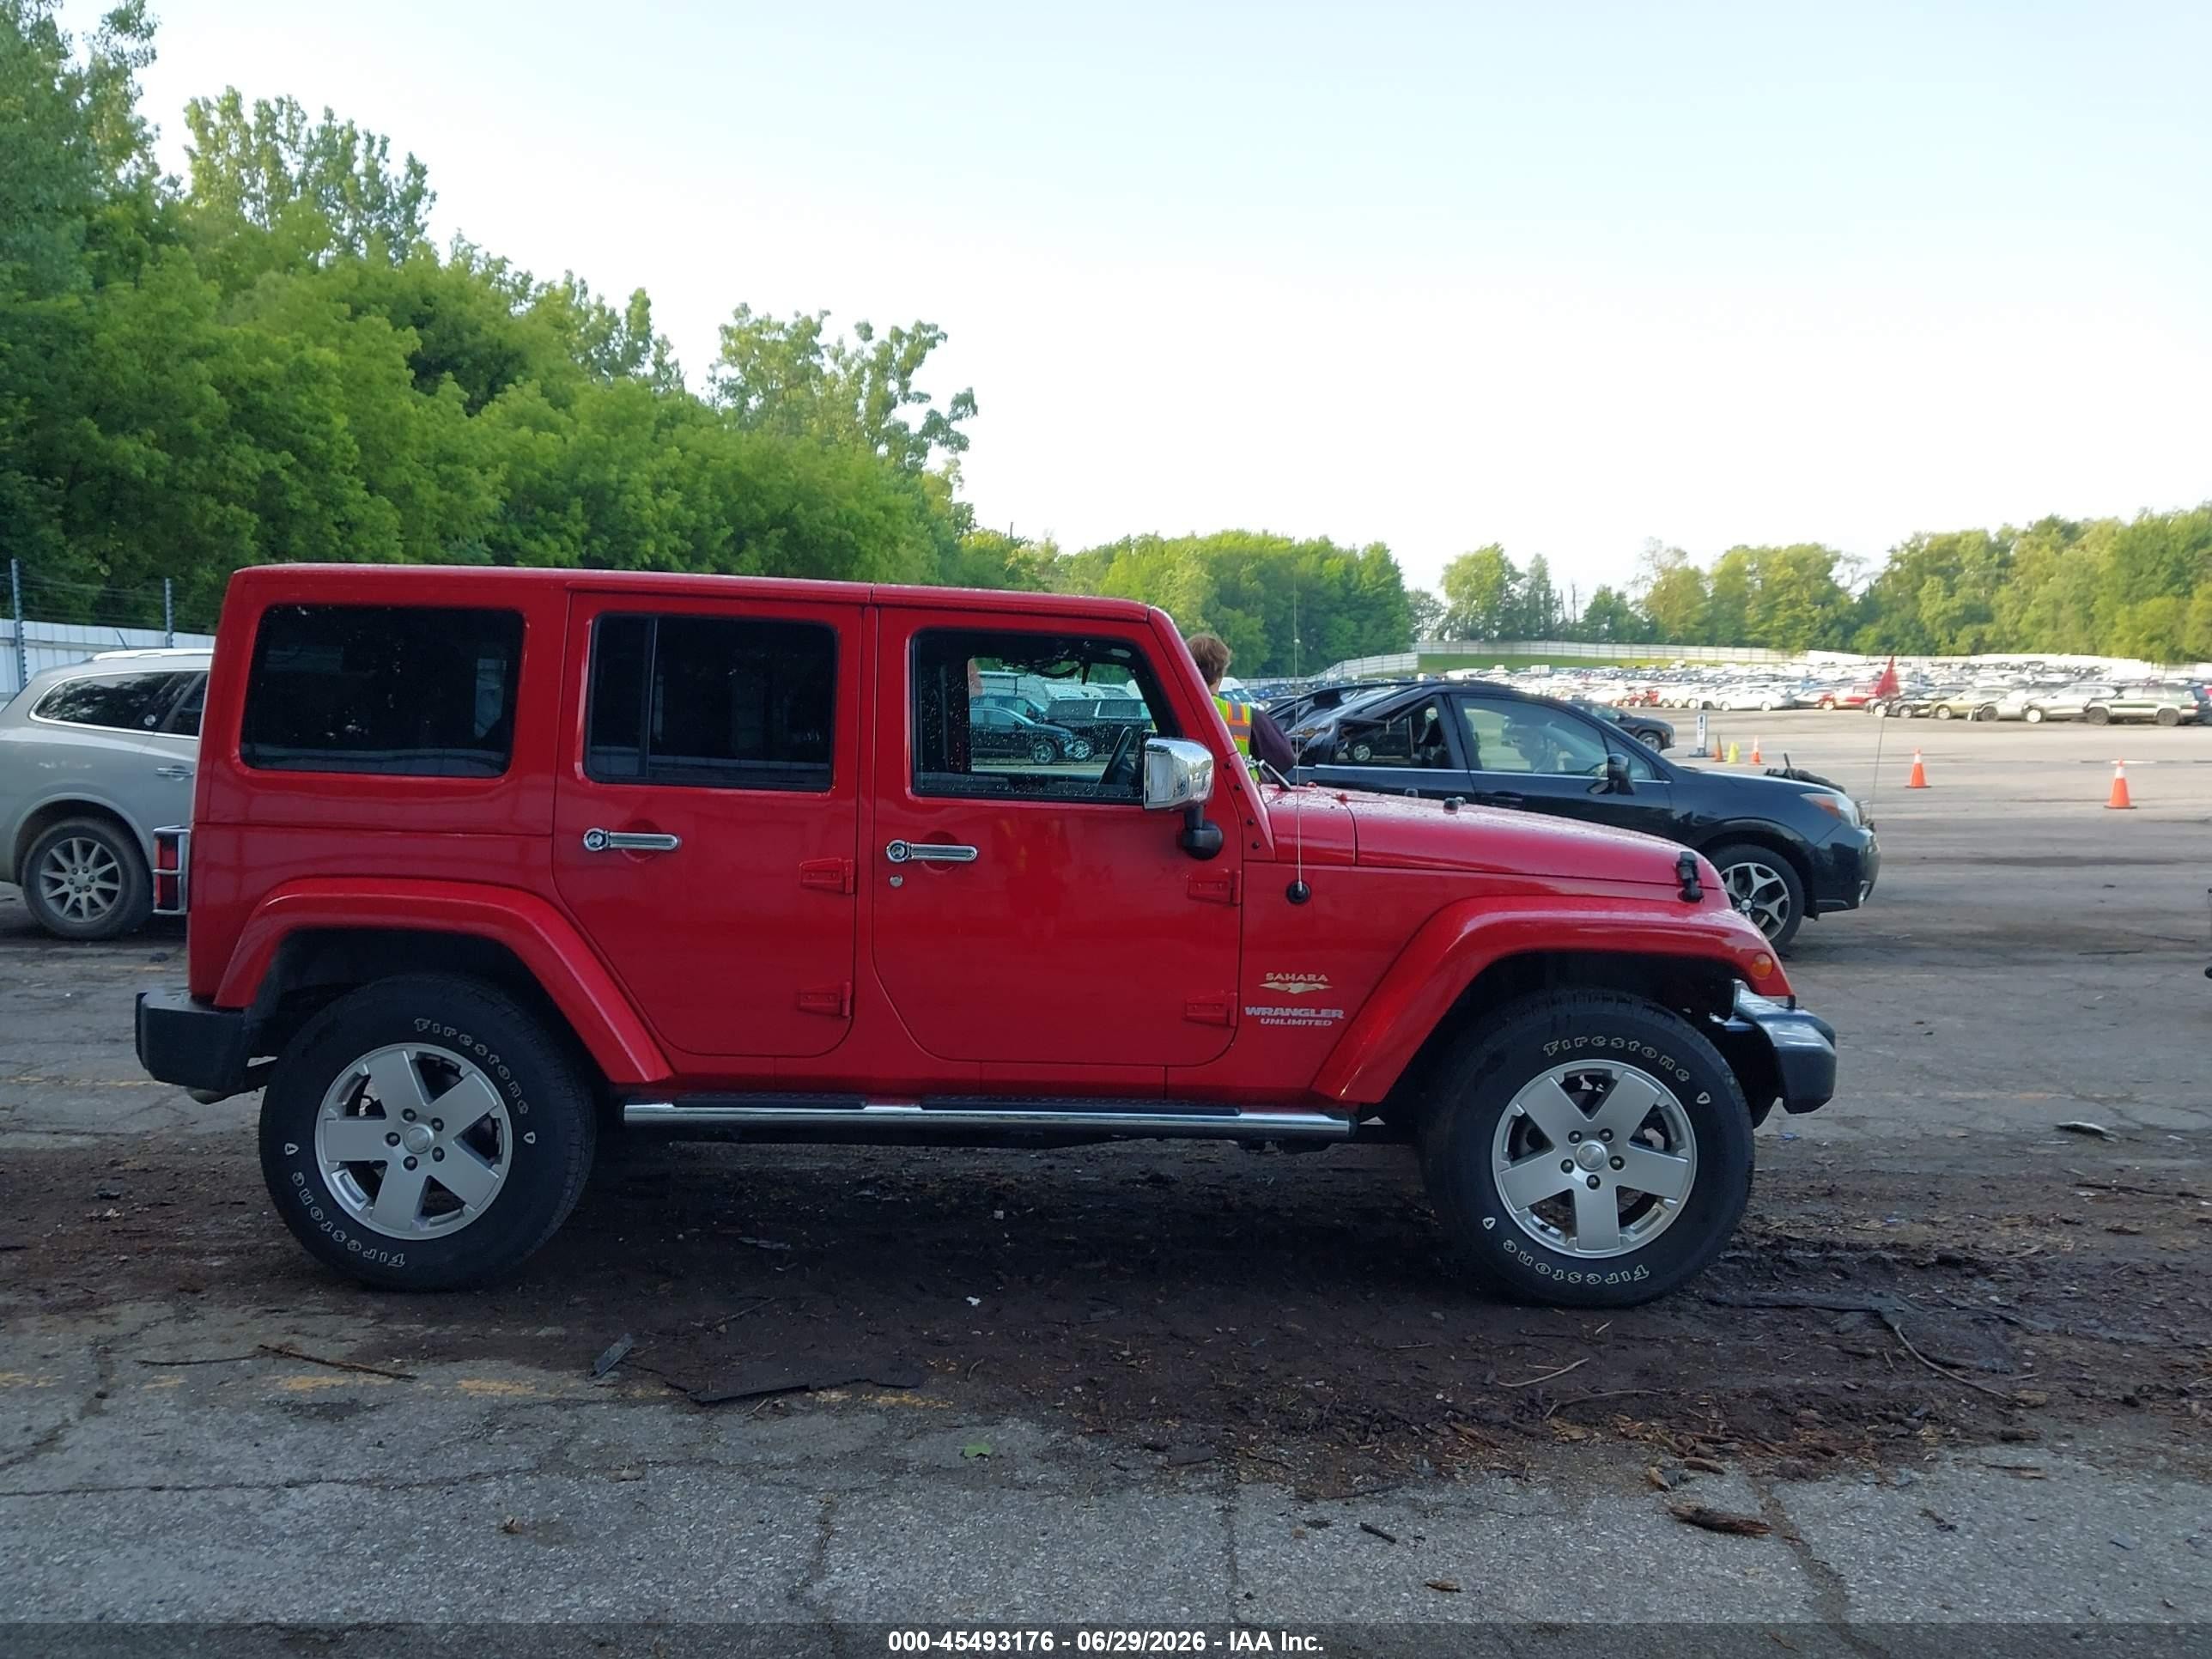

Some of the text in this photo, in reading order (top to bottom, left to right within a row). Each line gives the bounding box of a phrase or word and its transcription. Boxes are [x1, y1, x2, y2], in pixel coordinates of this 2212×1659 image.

[1266, 973, 1328, 982] SAHARA
[1245, 1006, 1345, 1018] WRANGLER
[413, 1017, 530, 1115] Firestone
[1543, 1036, 1690, 1082] Firestone
[292, 1171, 406, 1267] Firestone
[1503, 1239, 1650, 1285] Firestone
